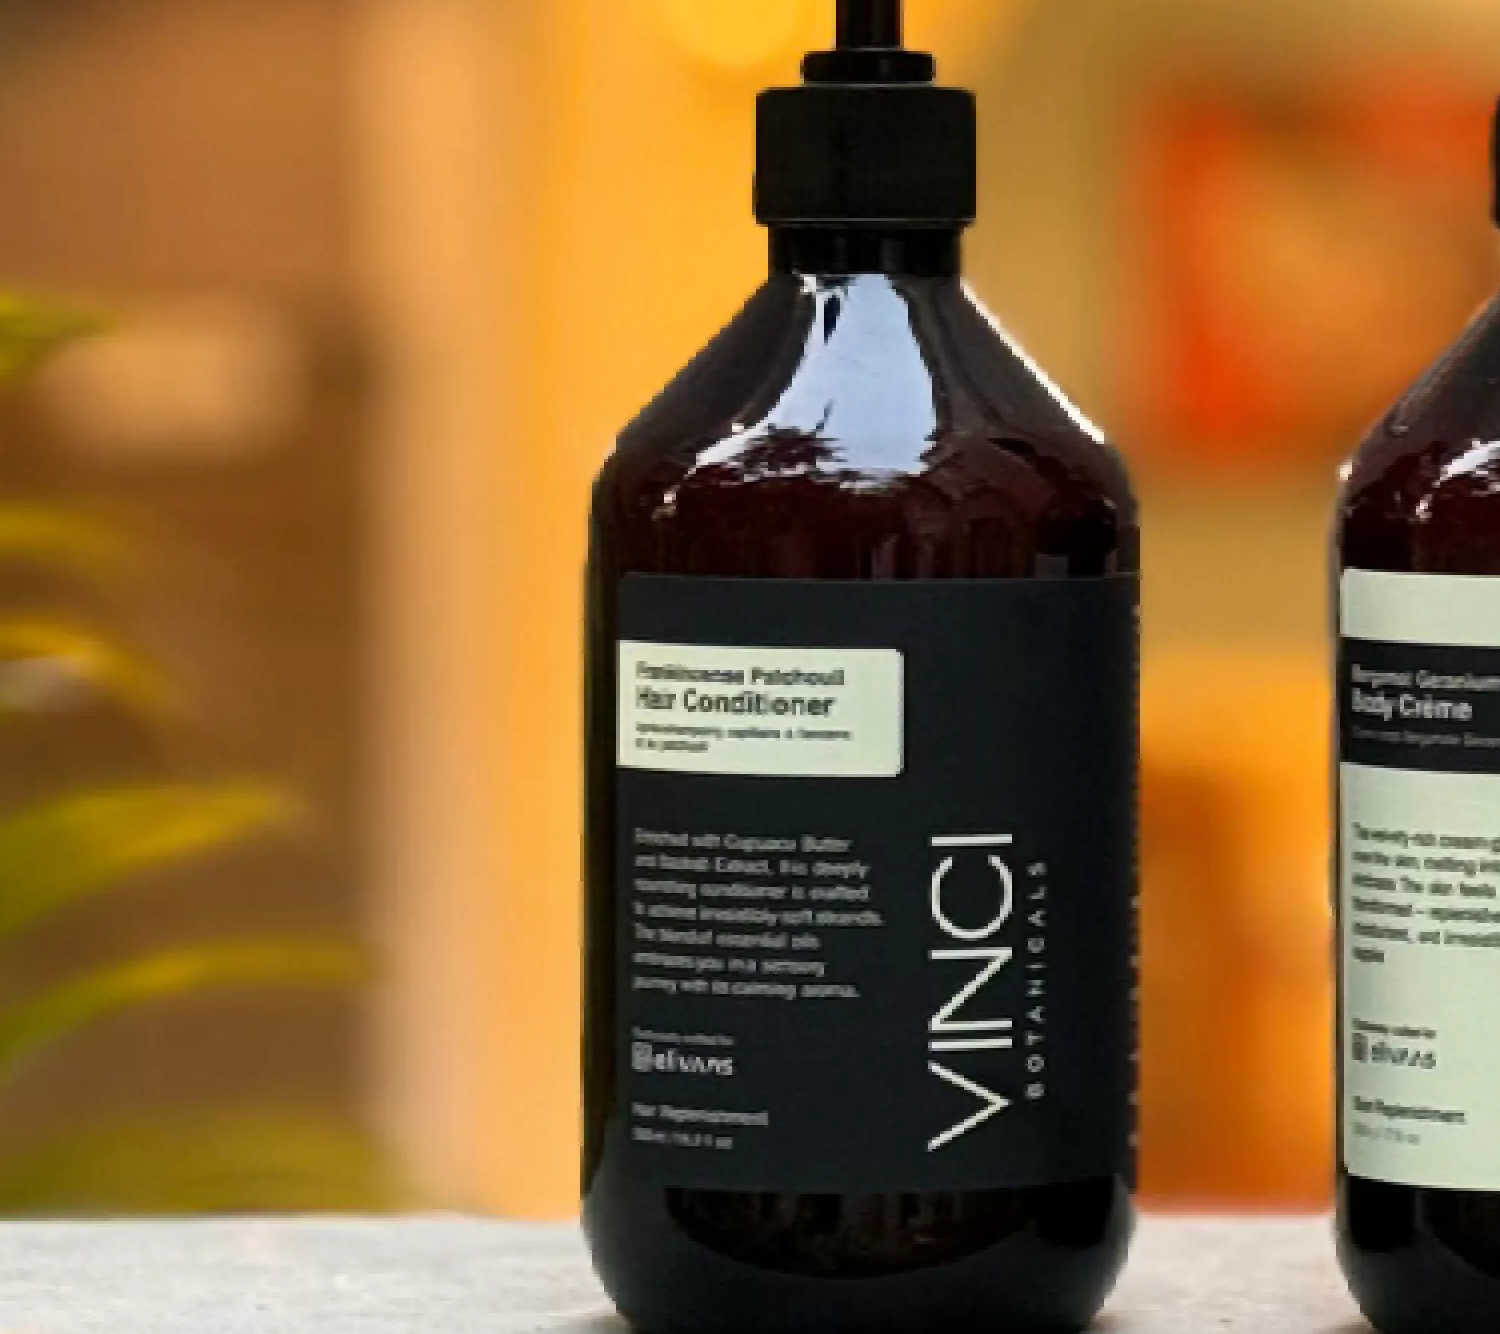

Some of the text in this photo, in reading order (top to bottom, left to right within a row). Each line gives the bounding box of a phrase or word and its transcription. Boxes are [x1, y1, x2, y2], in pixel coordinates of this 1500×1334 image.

[751, 666, 845, 686] Patchouli
[635, 684, 837, 717] Hair Conditioner
[1351, 687, 1473, 722] Body Crème
[927, 833, 1013, 1153] VINCI
[1025, 861, 1048, 1099] BOTANICALS
